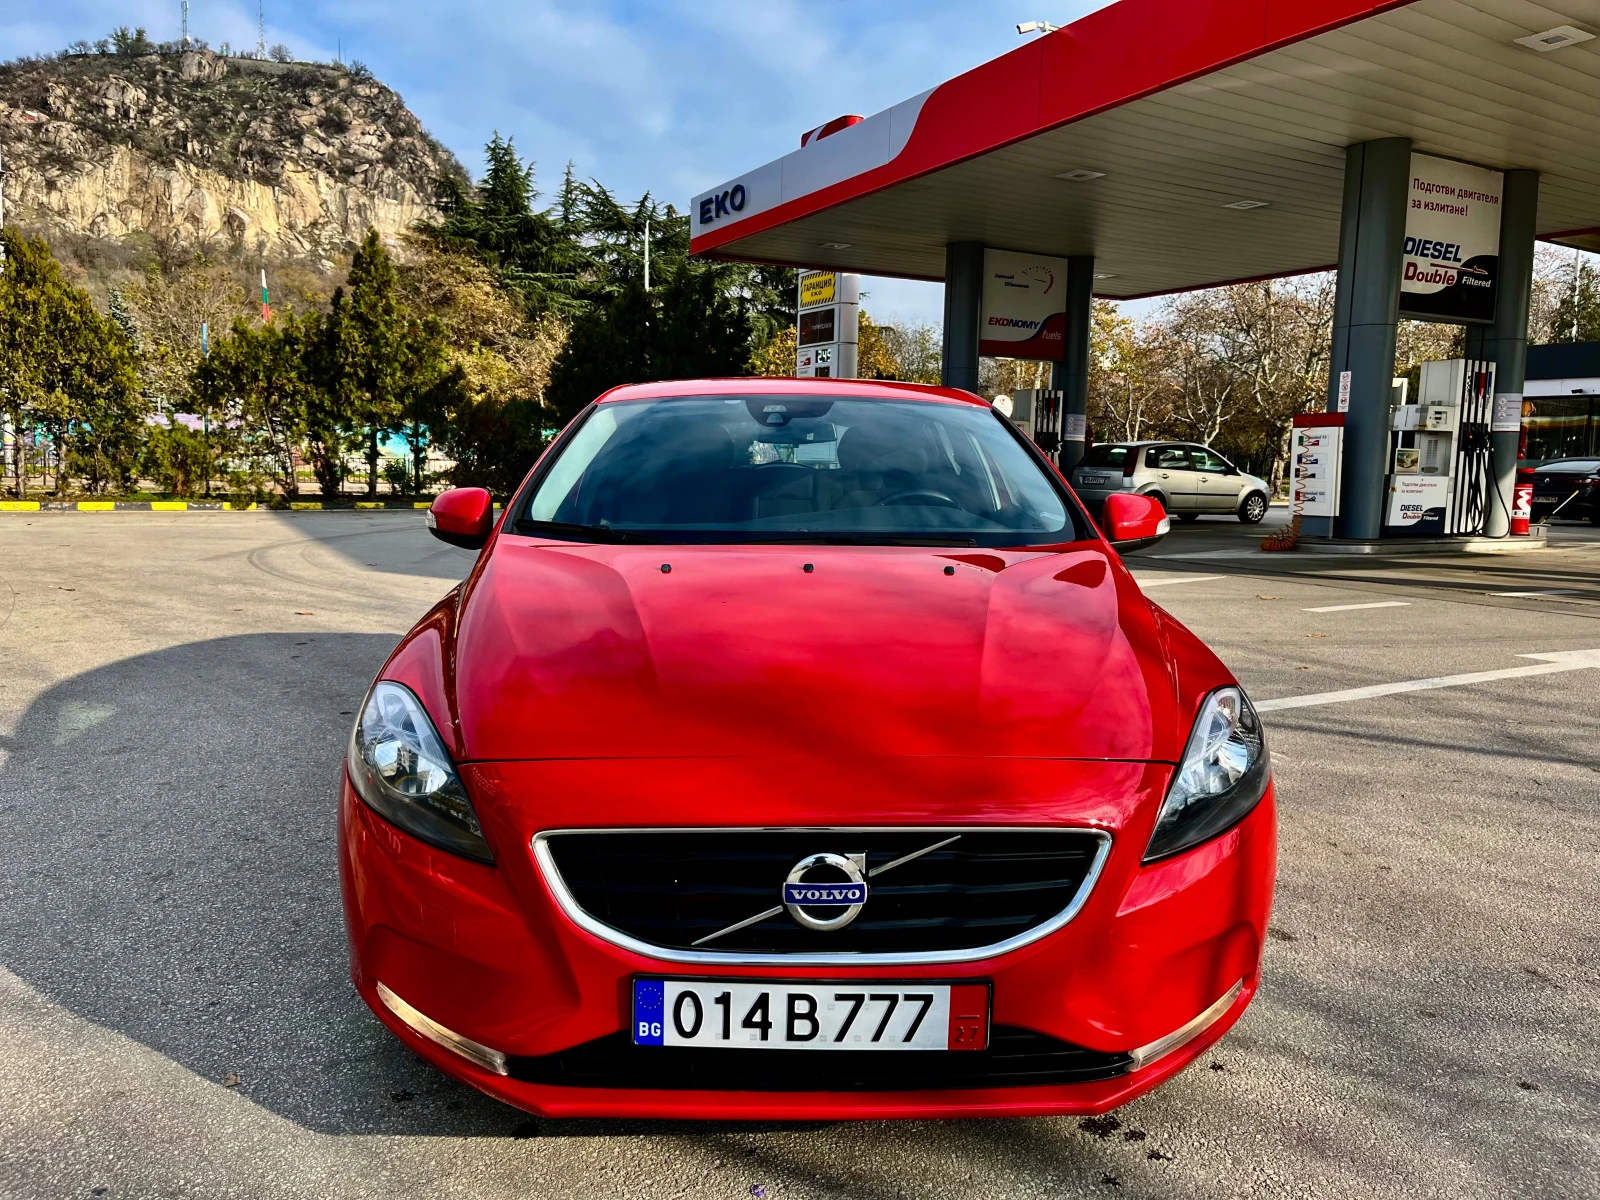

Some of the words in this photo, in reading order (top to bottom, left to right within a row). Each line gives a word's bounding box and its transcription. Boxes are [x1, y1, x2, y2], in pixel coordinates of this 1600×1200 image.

[1413, 178, 1455, 196] Подготви
[1457, 188, 1499, 205] двигателя
[700, 184, 746, 224] EKO
[1411, 199, 1421, 209] за
[1424, 200, 1468, 216] излитане!
[1403, 236, 1462, 262] DIESEL
[1404, 261, 1456, 286] Double
[1462, 276, 1492, 288] Filtered
[803, 278, 832, 293] ГАРАНЦИЯ
[988, 316, 1041, 330] EKONOMY
[1042, 330, 1062, 340] fuels
[1400, 504, 1423, 512] DIESEL
[1402, 512, 1422, 520] Double
[789, 888, 861, 900] VOLVO
[638, 1021, 661, 1037] BG
